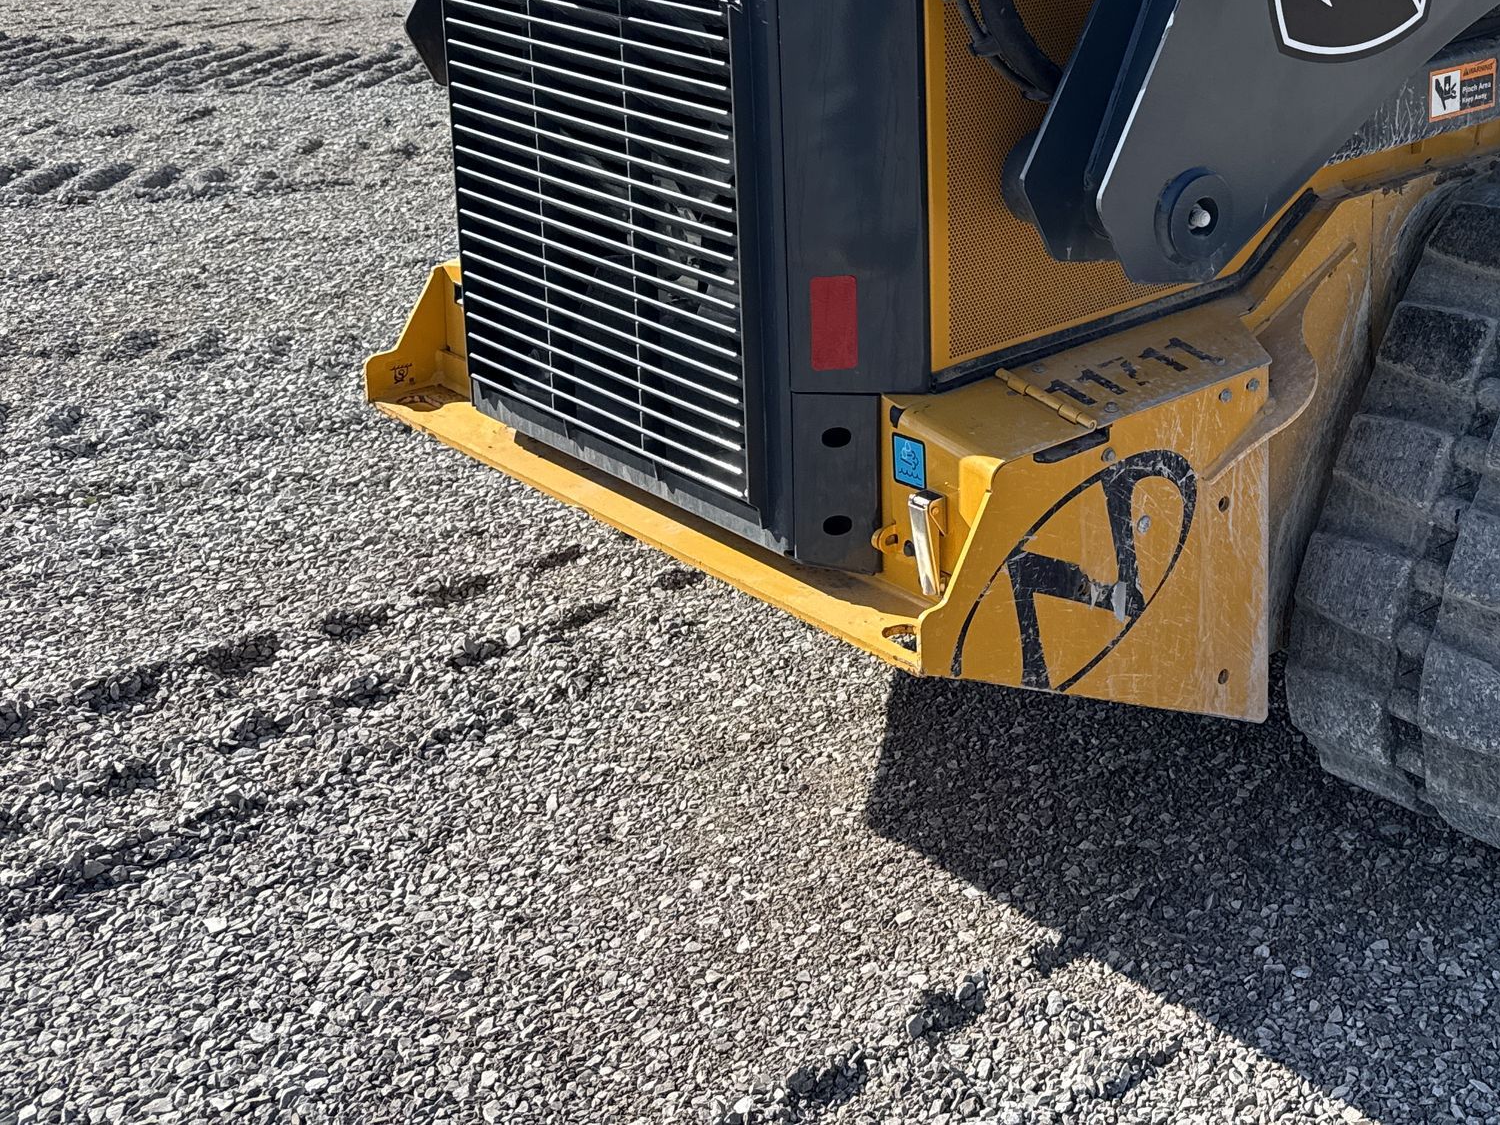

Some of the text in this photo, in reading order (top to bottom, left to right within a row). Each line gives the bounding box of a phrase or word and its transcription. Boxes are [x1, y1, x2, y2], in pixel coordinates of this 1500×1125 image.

[1467, 63, 1493, 75] WARNING
[1461, 81, 1492, 94] Pinch Area
